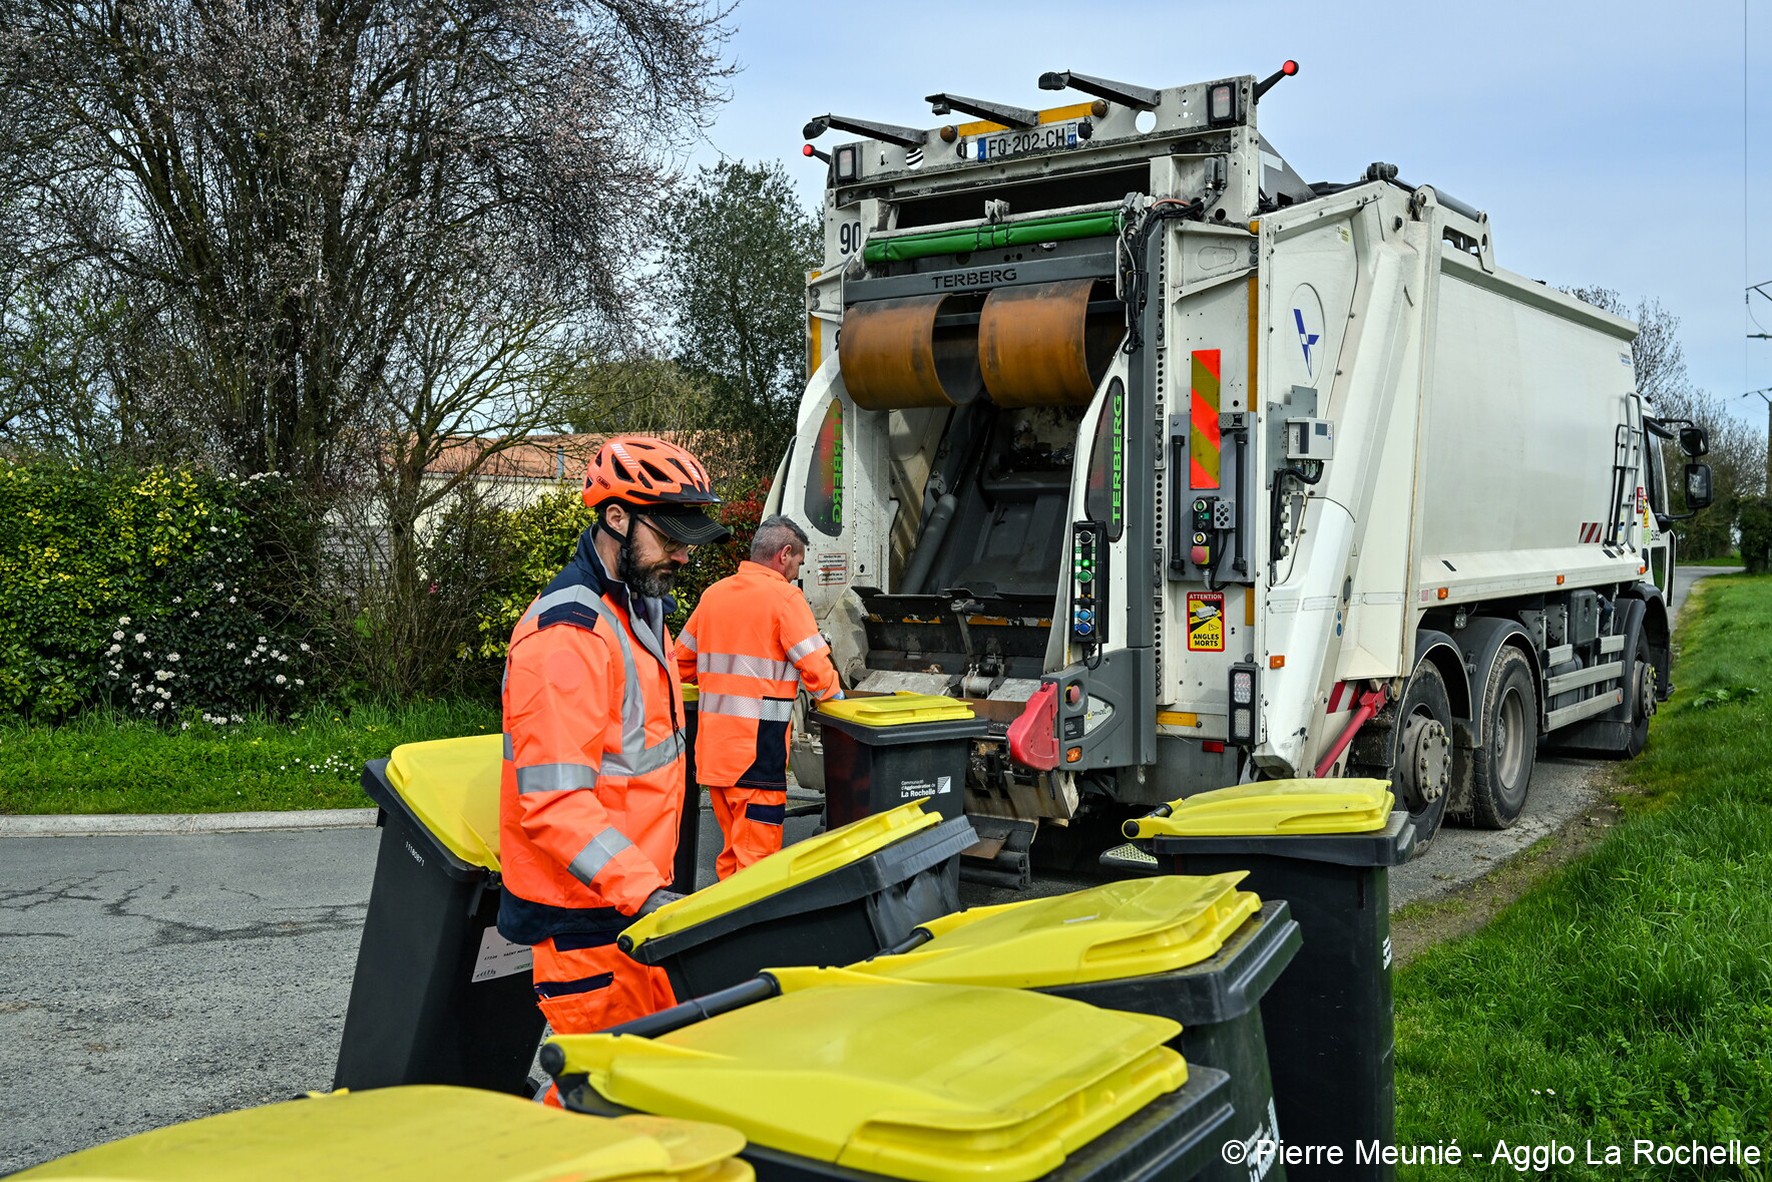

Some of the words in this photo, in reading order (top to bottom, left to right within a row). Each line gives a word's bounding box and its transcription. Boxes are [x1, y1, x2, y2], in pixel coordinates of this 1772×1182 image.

[988, 127, 1066, 158] FQ-202-CH
[840, 221, 861, 255] 90
[931, 268, 1017, 289] TERBERG
[832, 404, 843, 524] TERBERG
[1112, 395, 1123, 525] TERBERG
[910, 788, 936, 797] Rochelle
